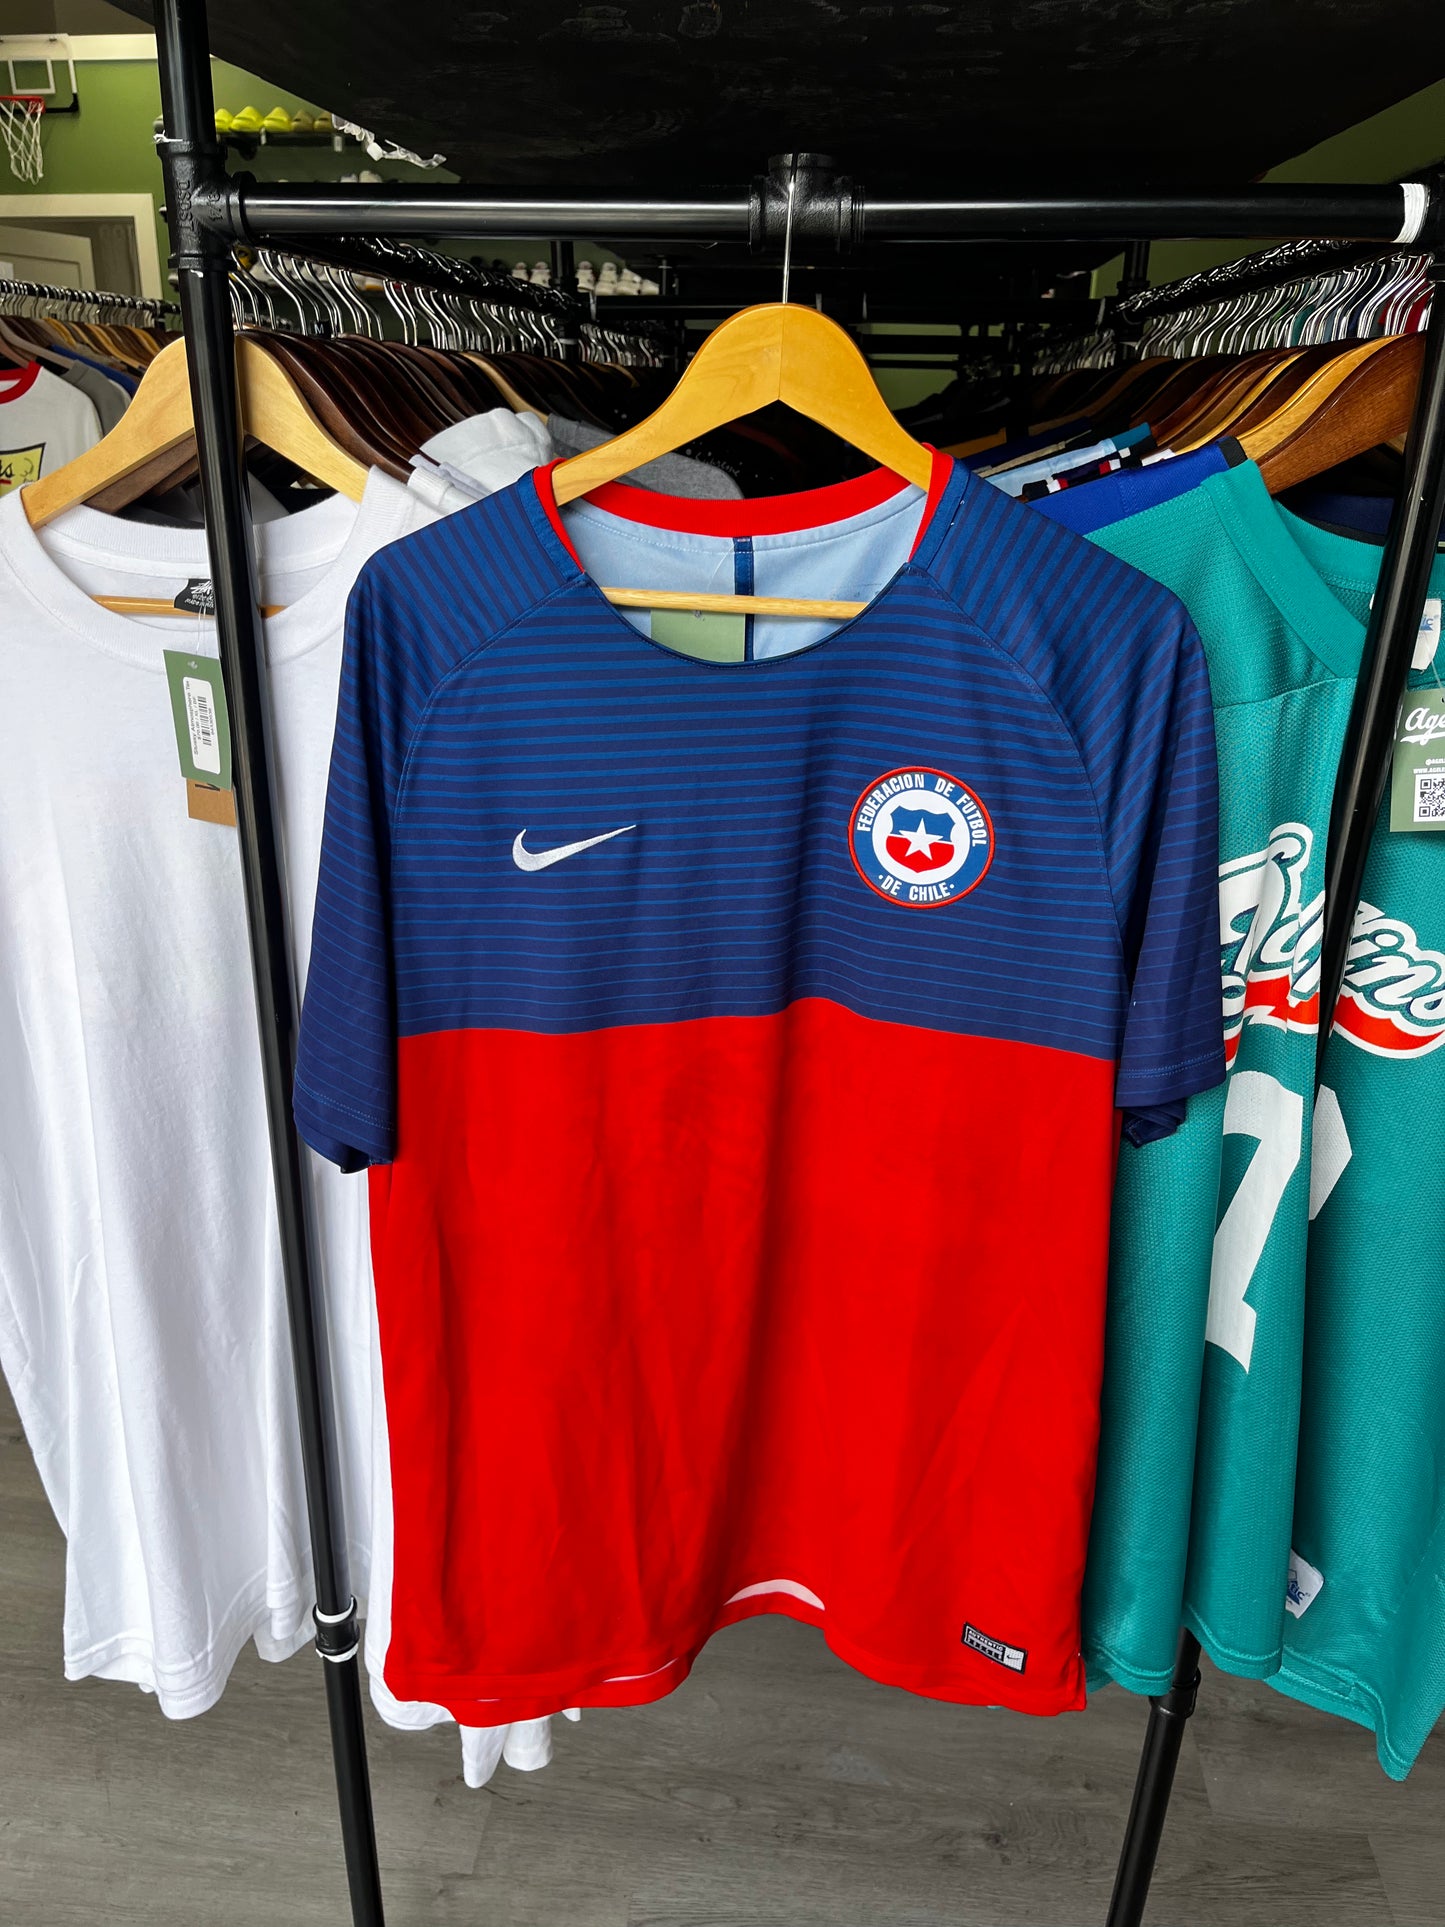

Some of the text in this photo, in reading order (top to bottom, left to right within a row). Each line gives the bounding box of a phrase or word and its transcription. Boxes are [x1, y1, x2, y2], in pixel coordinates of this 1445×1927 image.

[314, 323, 325, 335] M
[857, 773, 988, 847] FEDERACION DE FUTBOL
[968, 1630, 1004, 1651] AUTHENTIC
